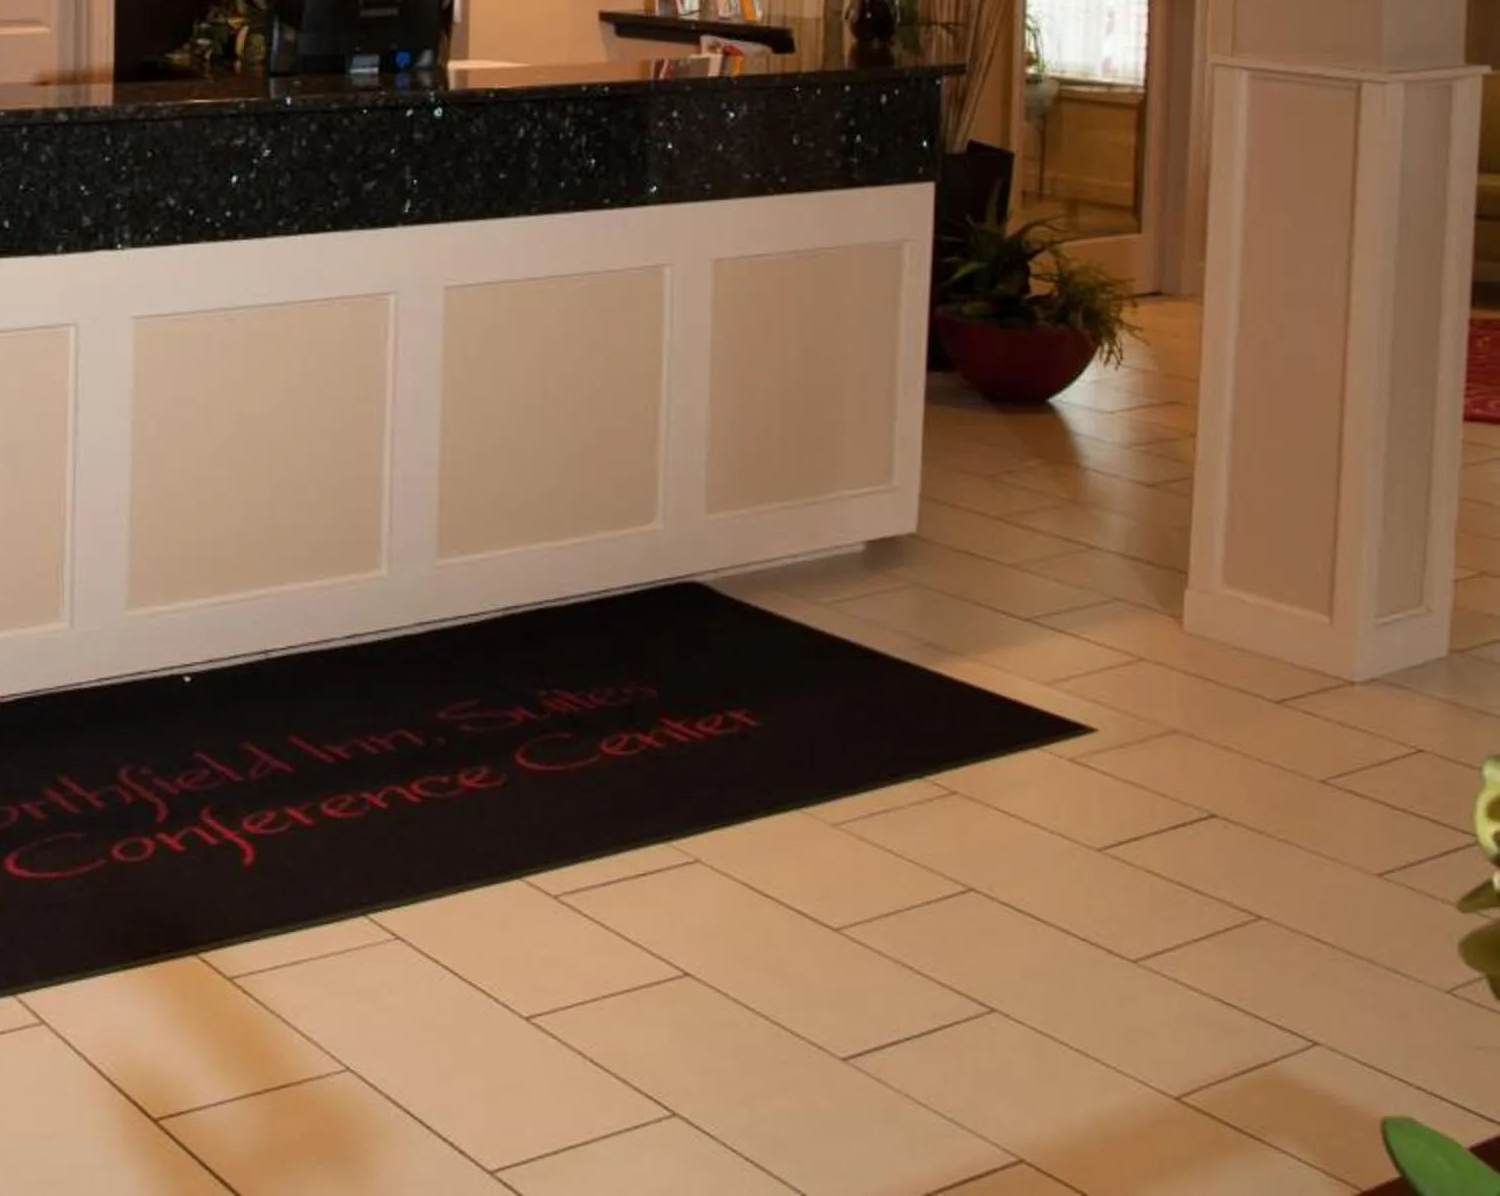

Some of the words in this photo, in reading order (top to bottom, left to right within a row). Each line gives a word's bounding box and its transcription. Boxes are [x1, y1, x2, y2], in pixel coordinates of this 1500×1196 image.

[435, 681, 660, 731] Suites
[2, 764, 508, 878] Conference
[514, 707, 762, 771] Center
